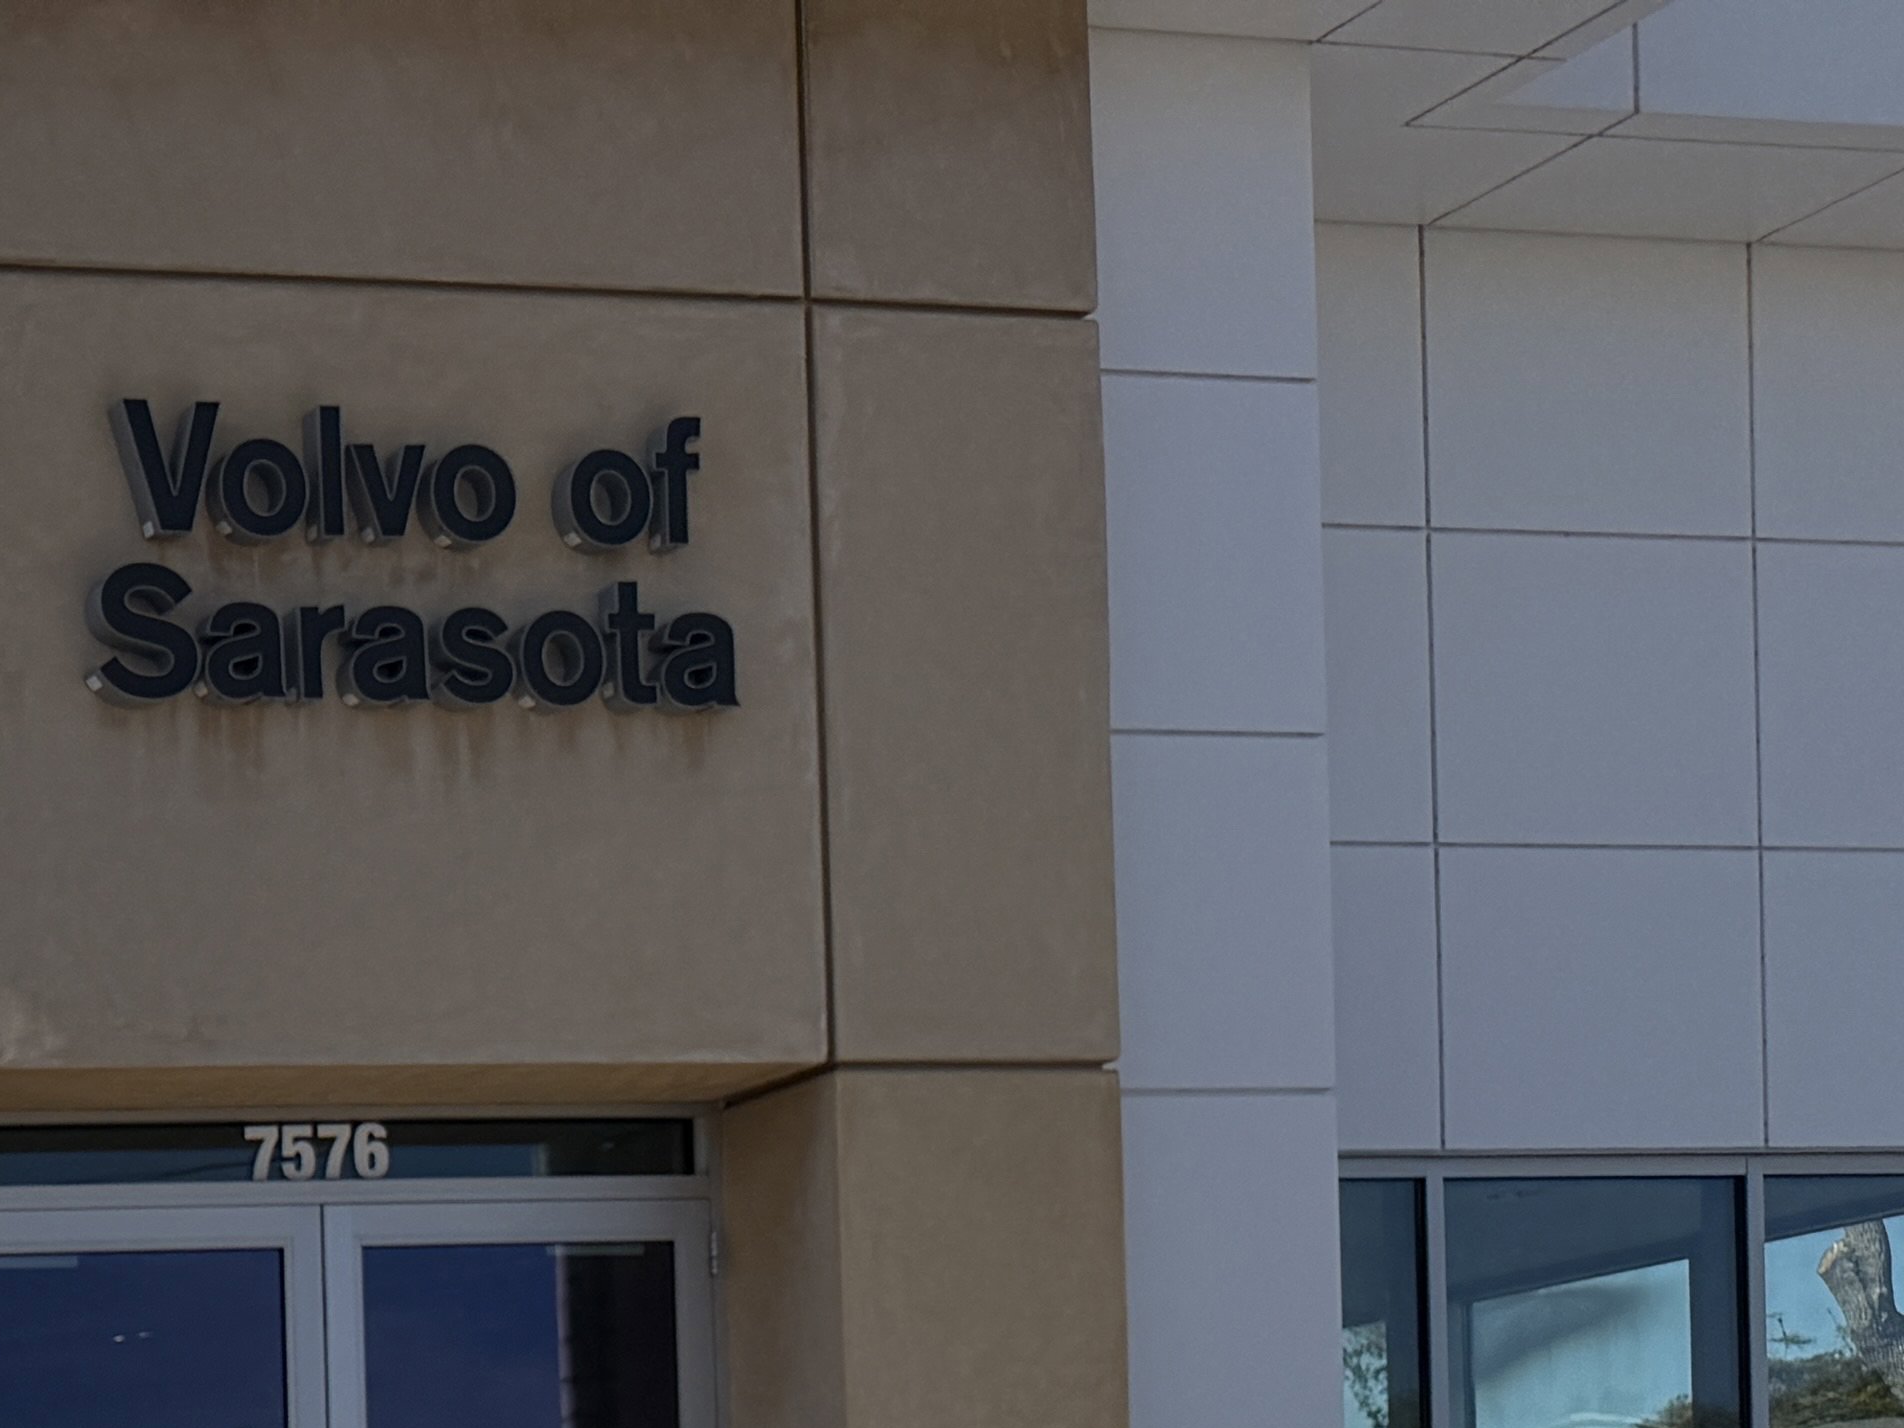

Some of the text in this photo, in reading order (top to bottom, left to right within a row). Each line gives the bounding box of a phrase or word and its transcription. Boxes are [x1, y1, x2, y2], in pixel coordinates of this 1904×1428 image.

[109, 398, 702, 553] Volvo of
[89, 562, 741, 708] Sarasota
[243, 1121, 390, 1182] 7576
